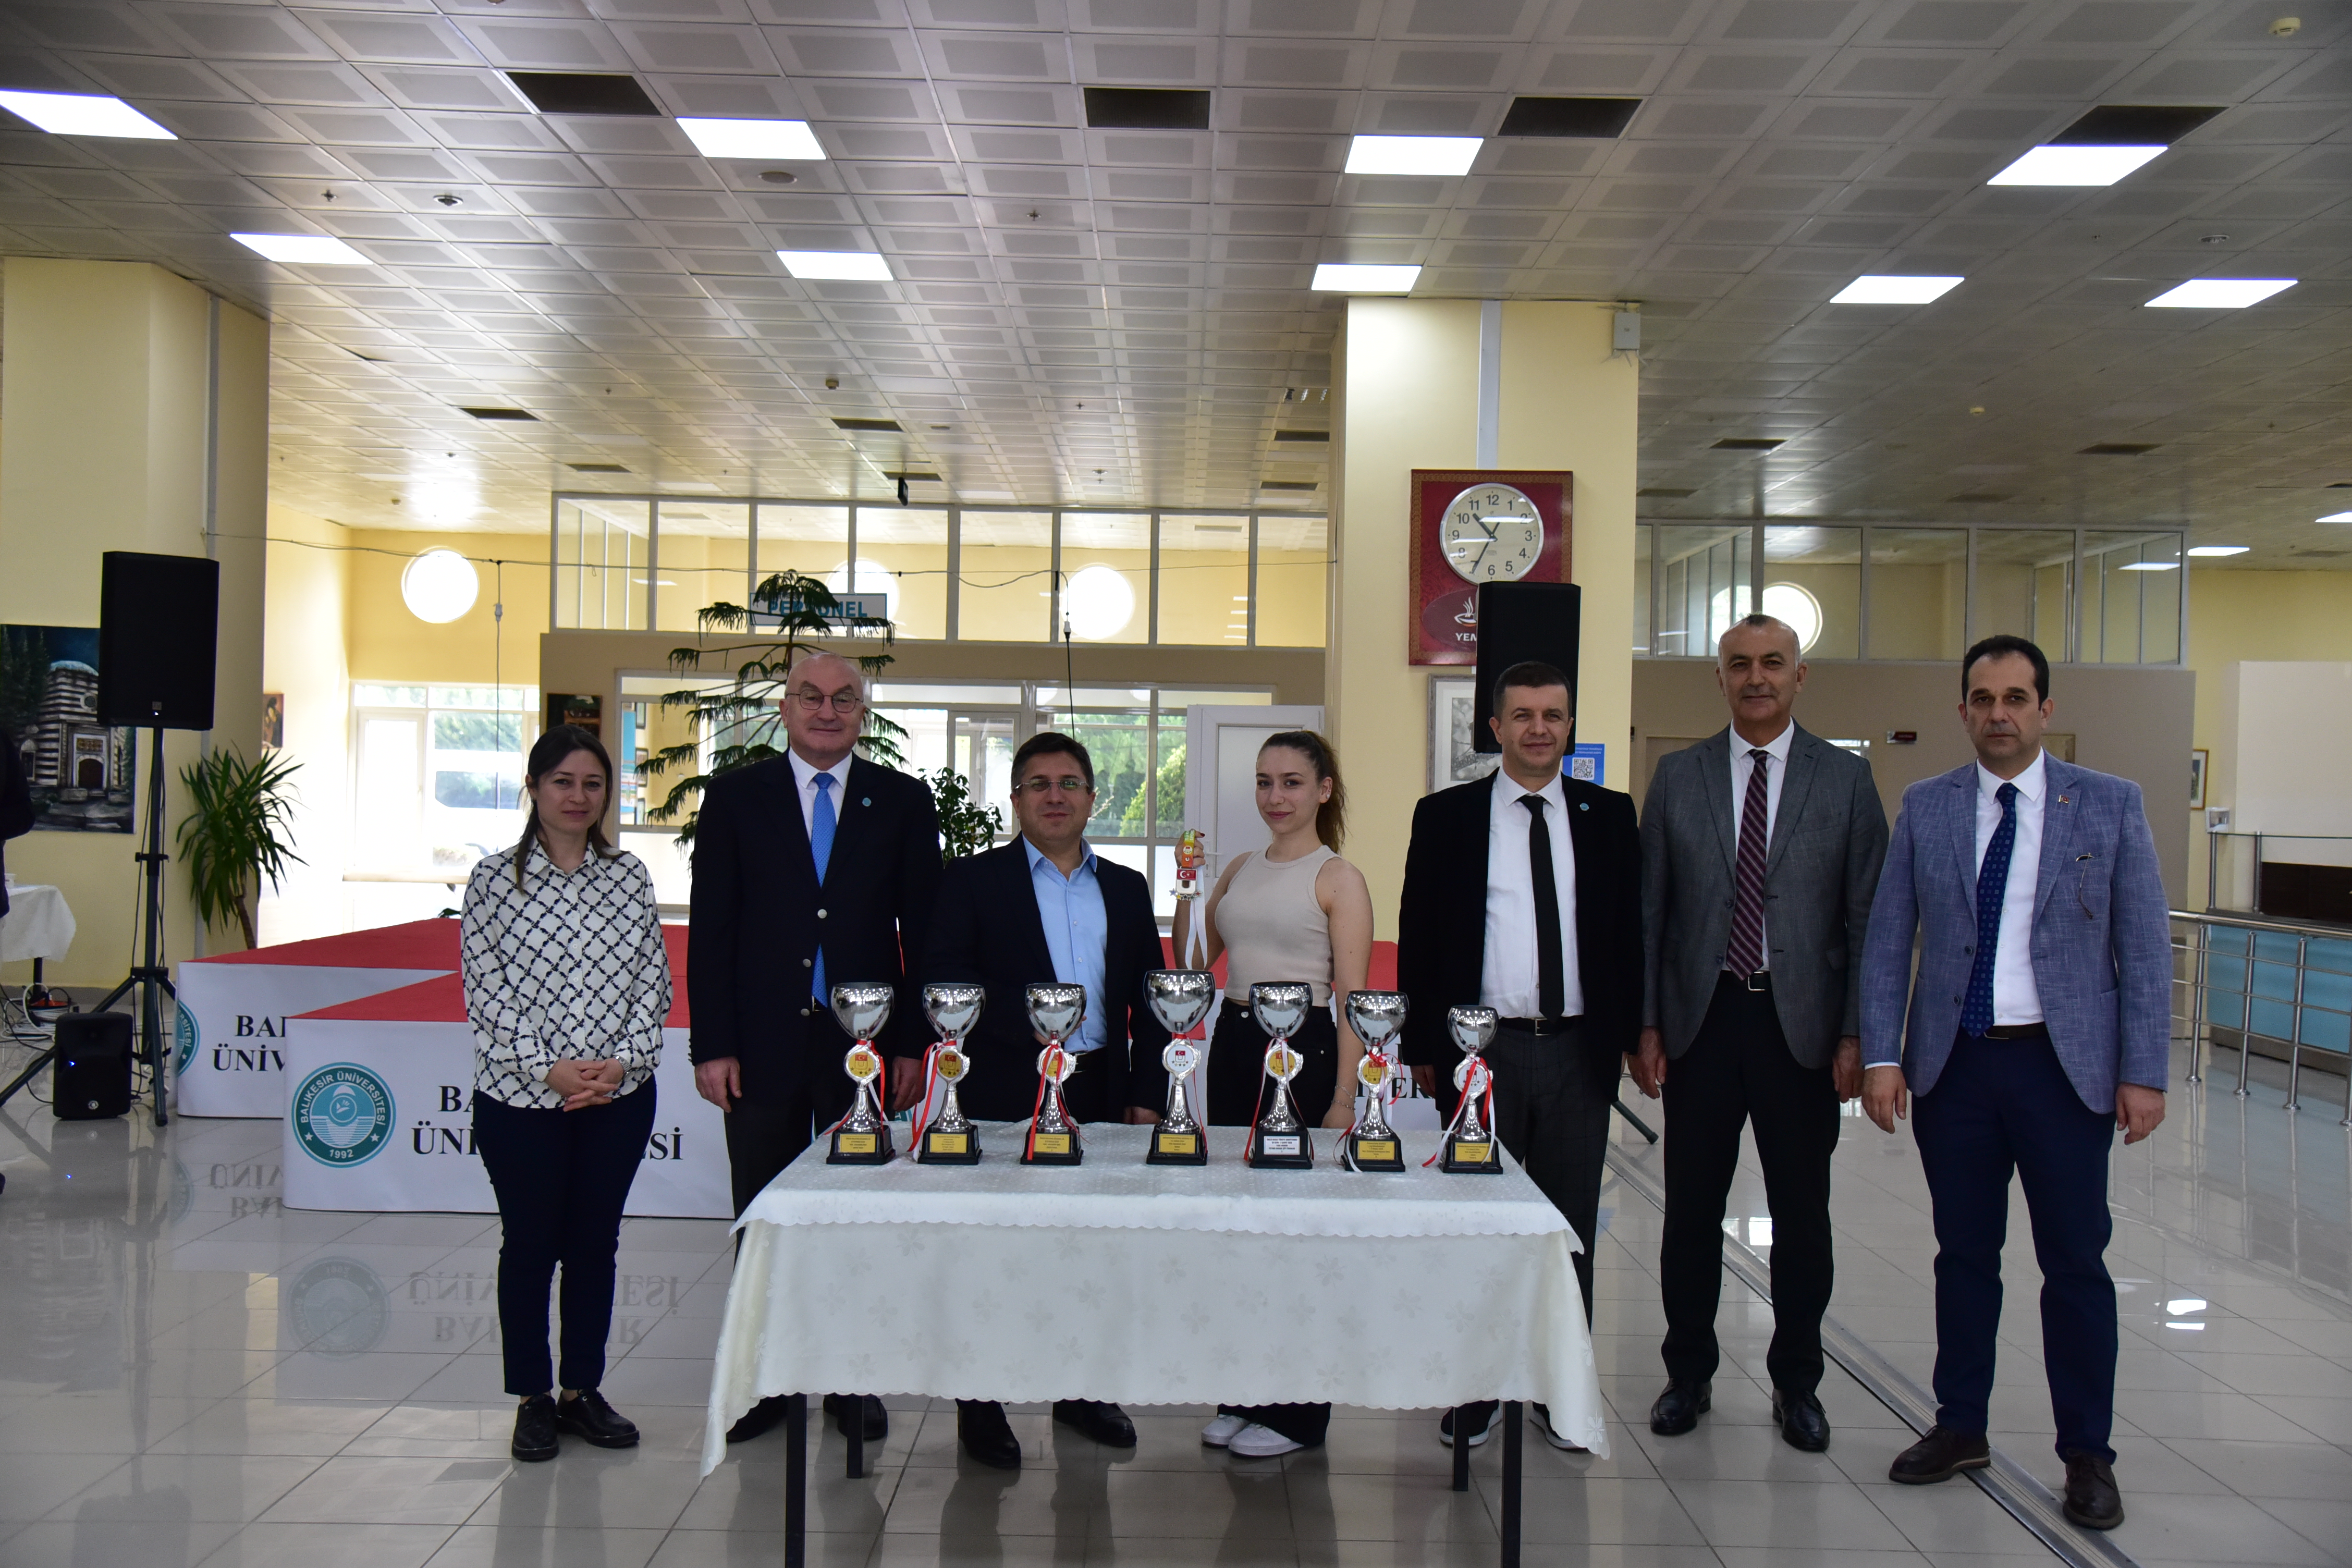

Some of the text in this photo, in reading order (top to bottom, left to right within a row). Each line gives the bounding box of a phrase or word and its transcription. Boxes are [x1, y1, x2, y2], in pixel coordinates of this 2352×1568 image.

[1468, 499, 1480, 511] 11
[1486, 495, 1499, 506] 12
[1508, 500, 1513, 511] 1
[1456, 513, 1469, 524] 10
[1520, 513, 1528, 524] 2
[1452, 530, 1460, 541] 9
[1525, 530, 1532, 542] 3
[1458, 547, 1466, 559] 8
[1519, 547, 1527, 559] 4
[1488, 565, 1495, 575] 6
[1505, 561, 1513, 572] 5
[768, 601, 867, 617] PERONEL
[300, 1074, 335, 1123] BALIKESİR
[329, 1149, 354, 1159] 1992
